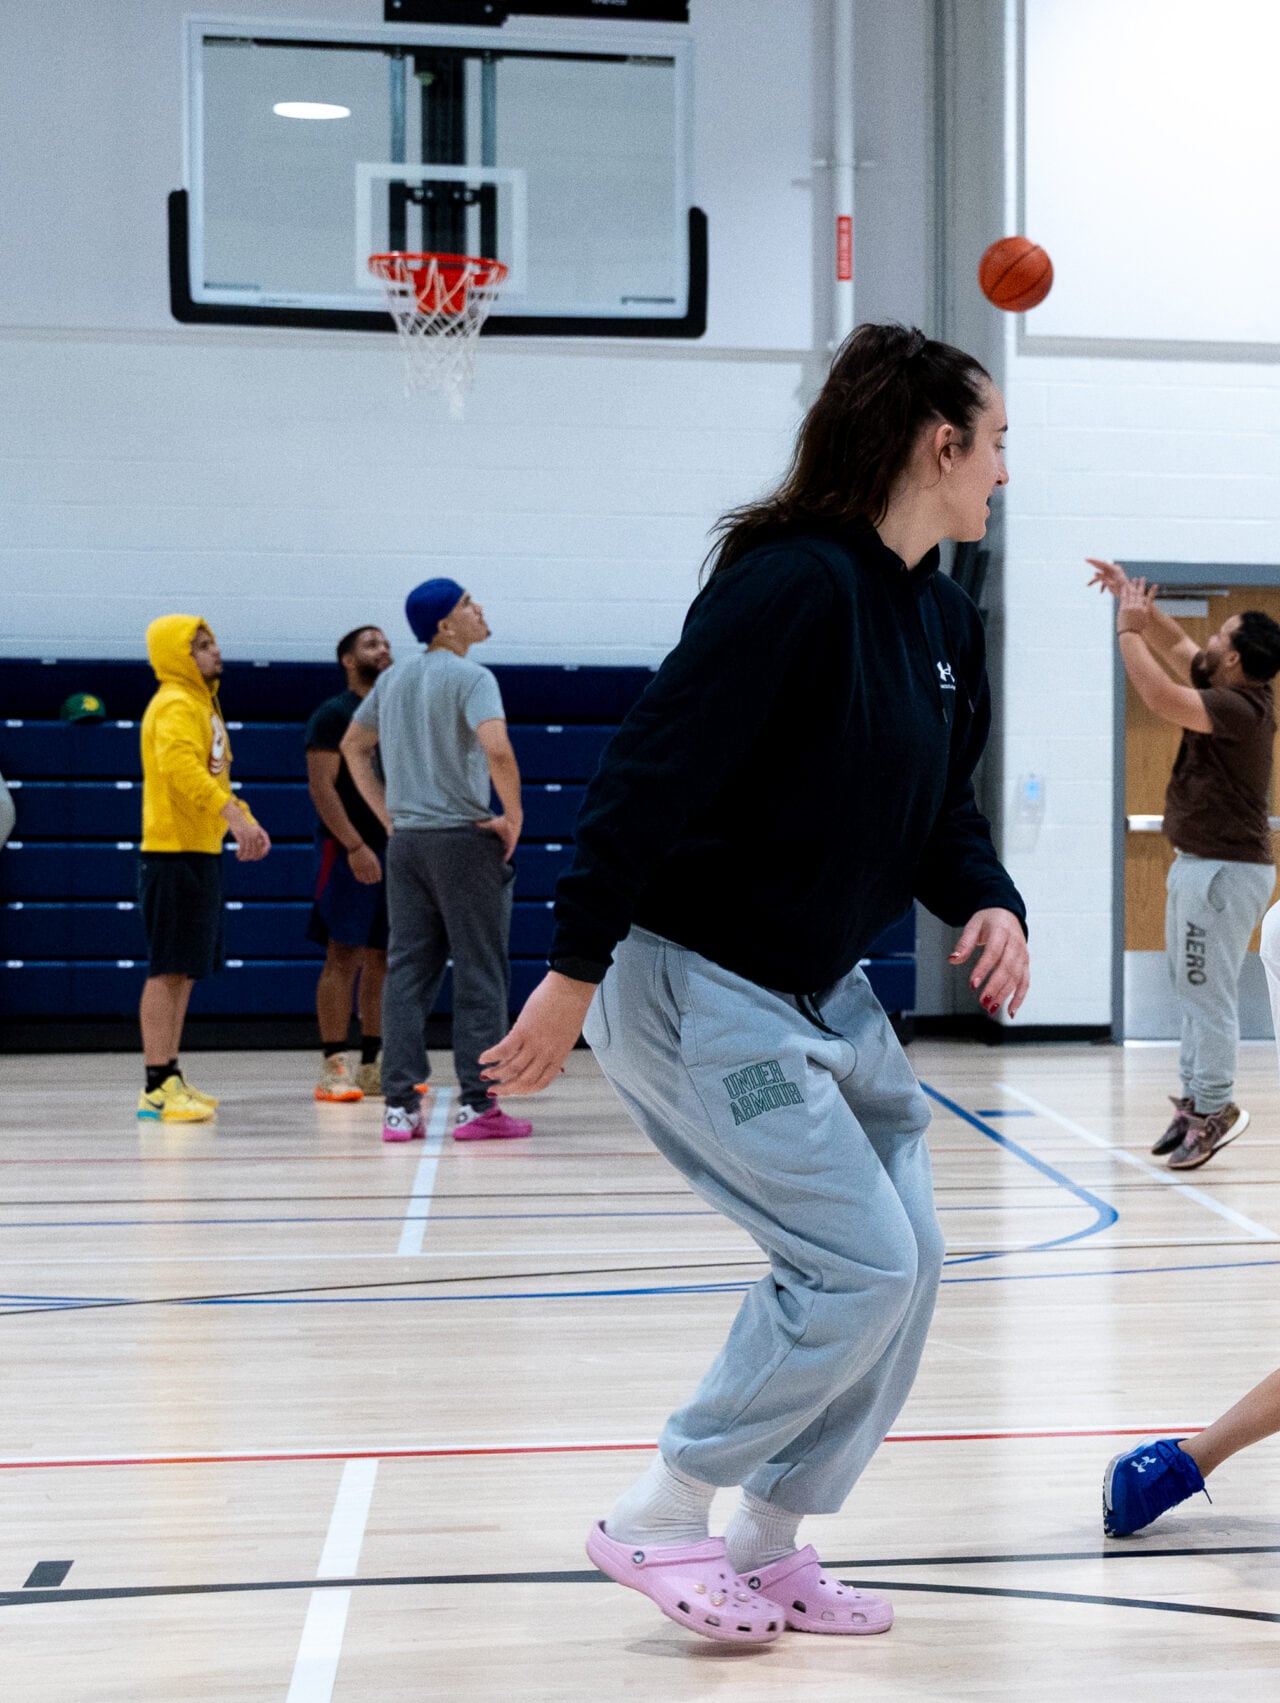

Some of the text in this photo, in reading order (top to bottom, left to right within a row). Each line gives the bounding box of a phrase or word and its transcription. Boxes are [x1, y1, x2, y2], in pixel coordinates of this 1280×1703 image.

[1186, 921, 1207, 986] AERO
[722, 1060, 786, 1100] UNDER
[730, 1082, 805, 1126] ARMOUR
